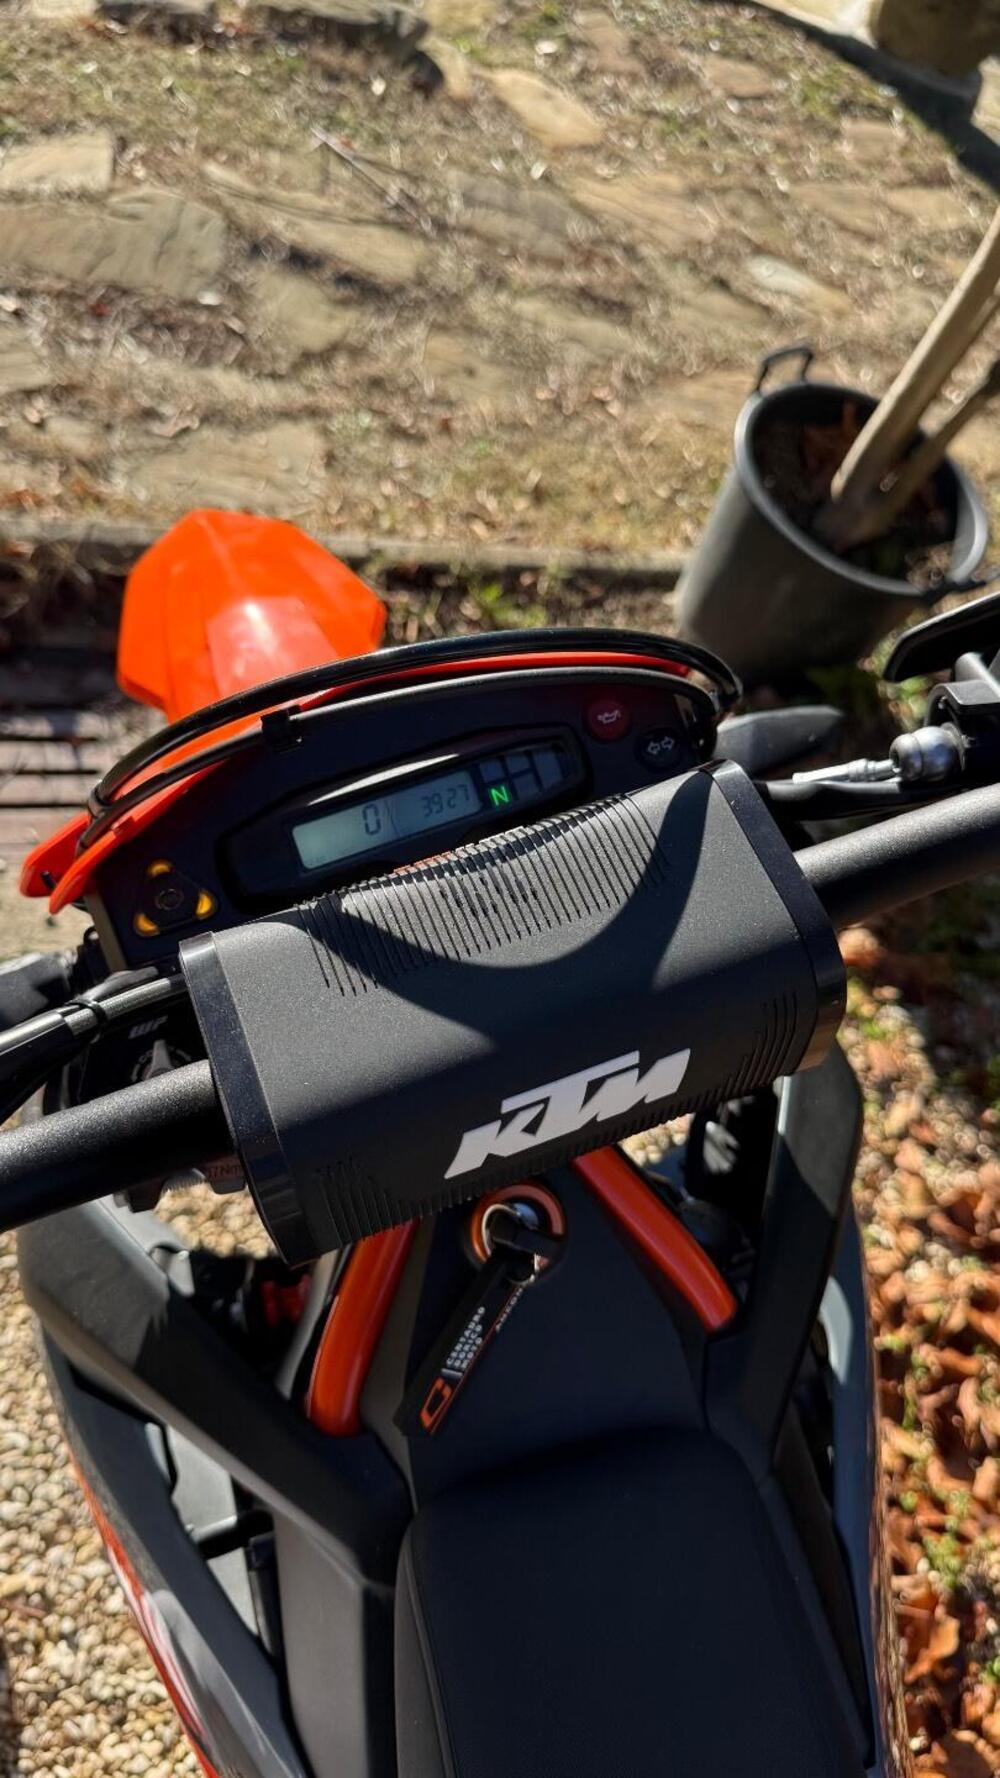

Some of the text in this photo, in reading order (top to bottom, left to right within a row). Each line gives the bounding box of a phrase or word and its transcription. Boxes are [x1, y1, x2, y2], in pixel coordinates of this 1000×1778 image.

[422, 784, 470, 818] 3927
[491, 786, 509, 806] N
[362, 804, 382, 836] 0
[444, 1048, 690, 1179] KTM
